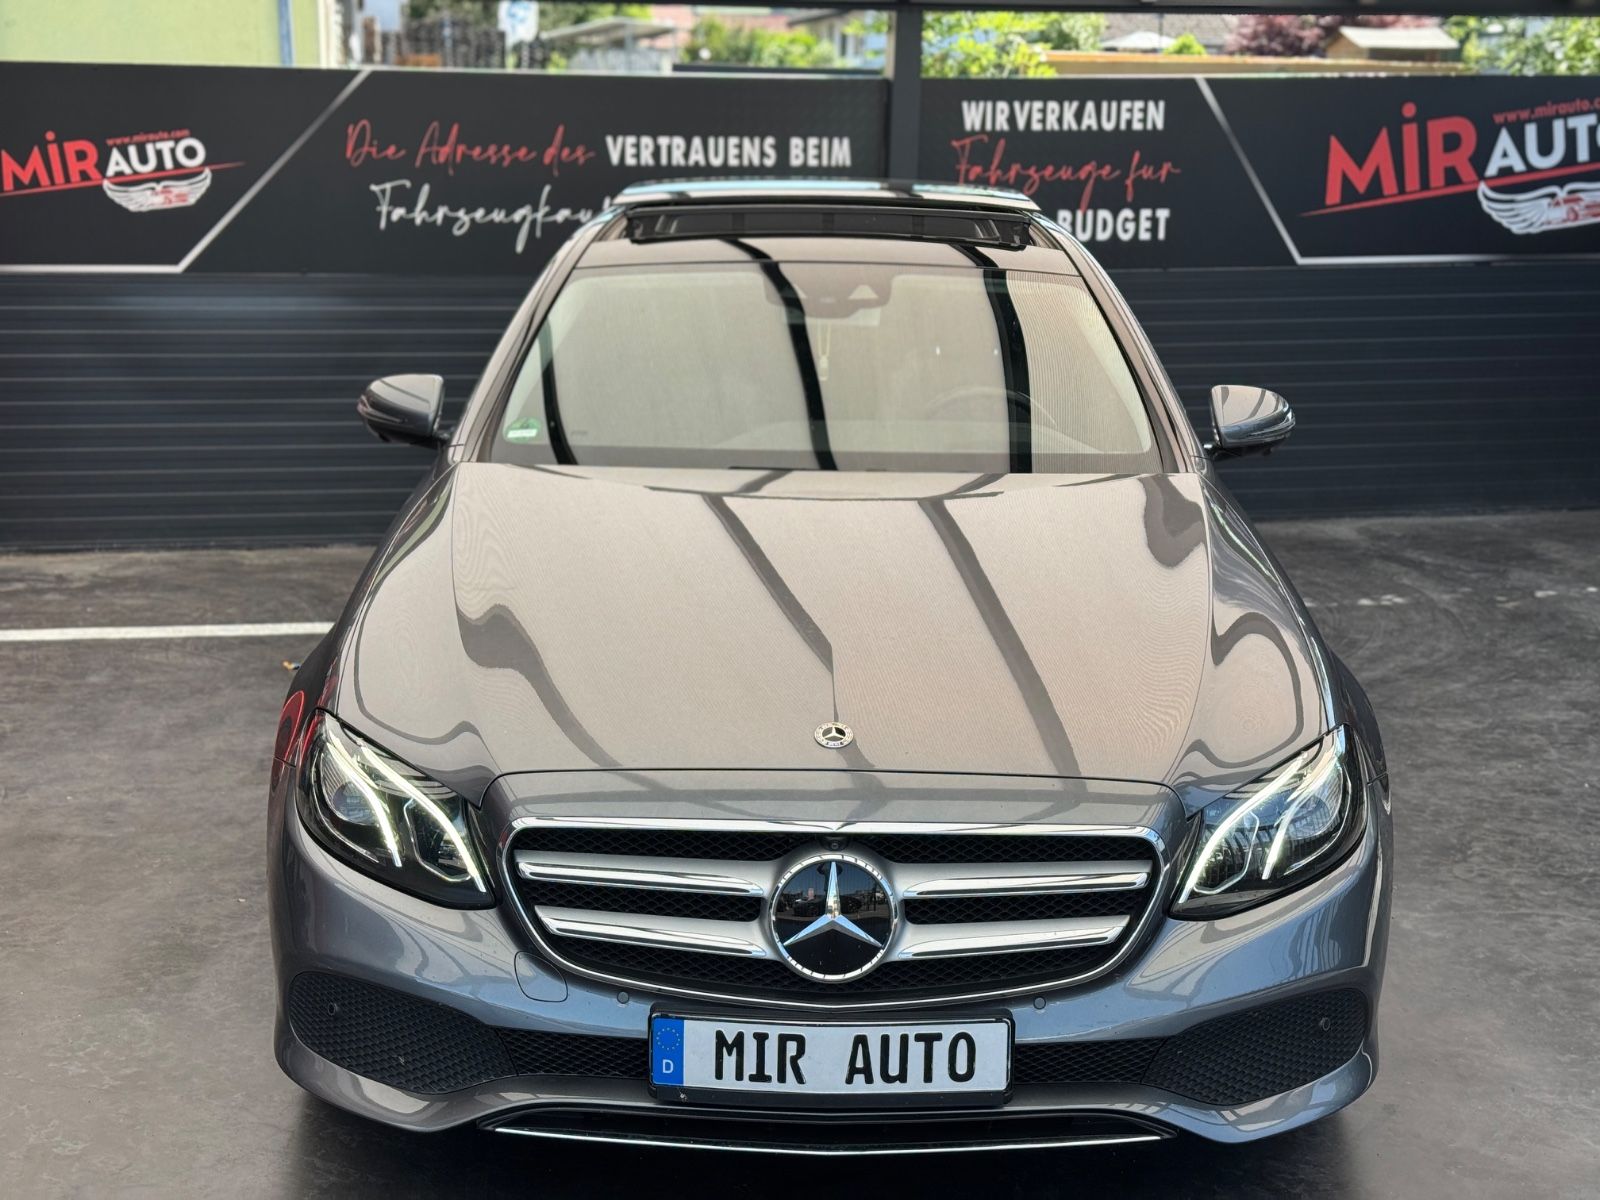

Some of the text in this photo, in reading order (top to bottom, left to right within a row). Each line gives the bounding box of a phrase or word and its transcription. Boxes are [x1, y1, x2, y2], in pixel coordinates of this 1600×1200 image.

[105, 137, 207, 178] AUTO
[345, 119, 852, 177] Die Adresse des VERTRAUENS BEIM
[951, 134, 1121, 212] Fahrzeuge
[1484, 112, 1600, 178] AUT
[369, 179, 612, 254] Fahrzeugkau
[1057, 207, 1171, 242] BUDGET
[662, 1029, 977, 1085] D MIR AUTO
